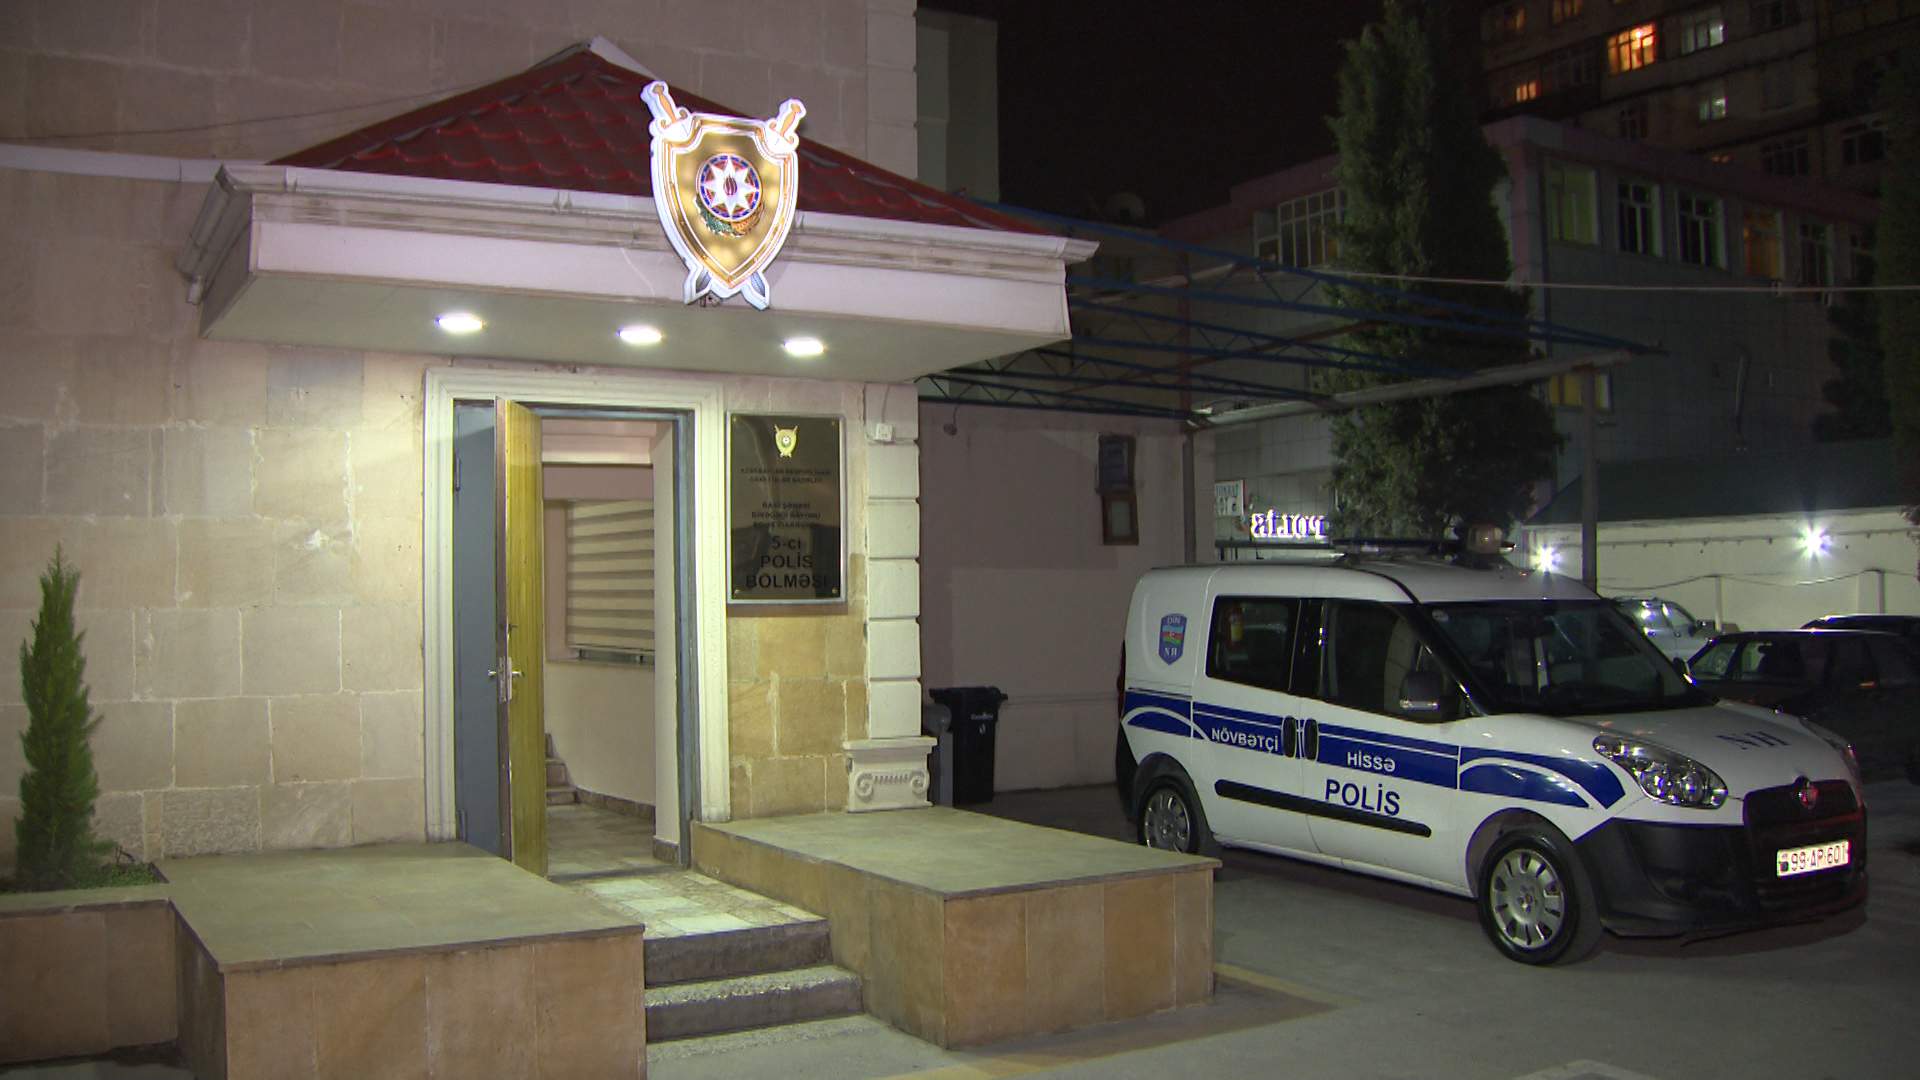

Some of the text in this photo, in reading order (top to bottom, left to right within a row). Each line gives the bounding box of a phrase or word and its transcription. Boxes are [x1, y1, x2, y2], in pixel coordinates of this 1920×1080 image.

[760, 551, 813, 569] POLİS
[1210, 727, 1396, 773] NÖVBƏTÇİ HİSSƏ
[1325, 778, 1400, 816] POLİS
